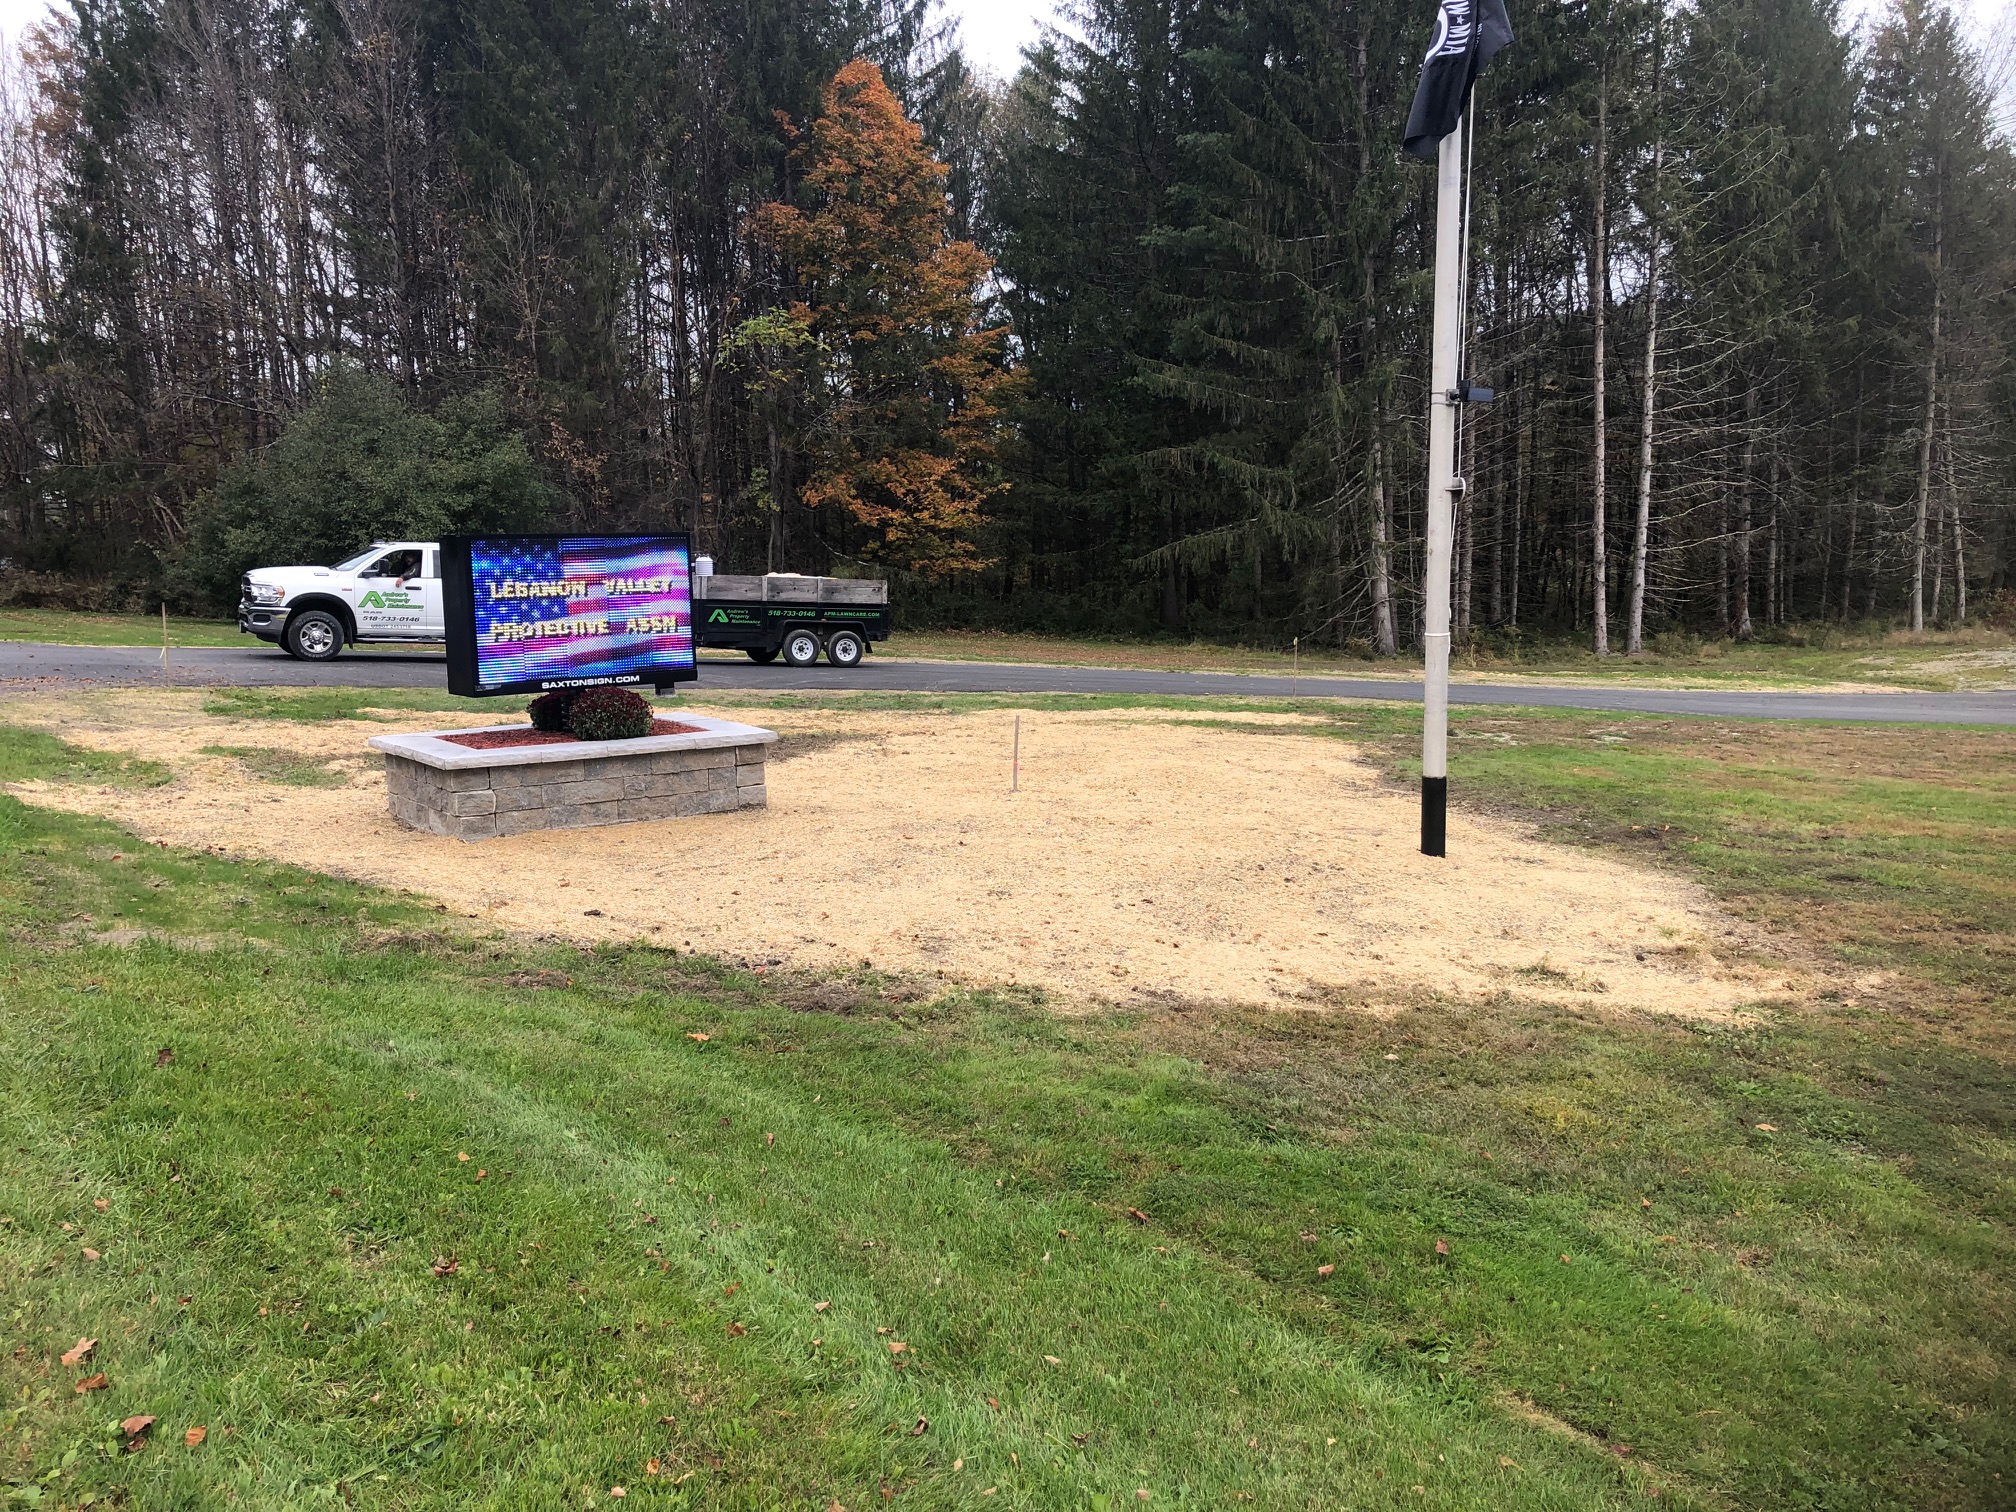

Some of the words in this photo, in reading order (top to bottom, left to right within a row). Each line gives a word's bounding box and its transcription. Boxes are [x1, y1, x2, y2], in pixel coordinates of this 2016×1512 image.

[1435, 22, 1471, 57] MIA
[489, 580, 587, 599] LEBANON
[603, 577, 674, 594] VALLEY
[767, 609, 816, 617] 518-733-0146
[490, 620, 610, 641] PROTECTIVE
[541, 675, 640, 690] SAXTONSIGN.COM
